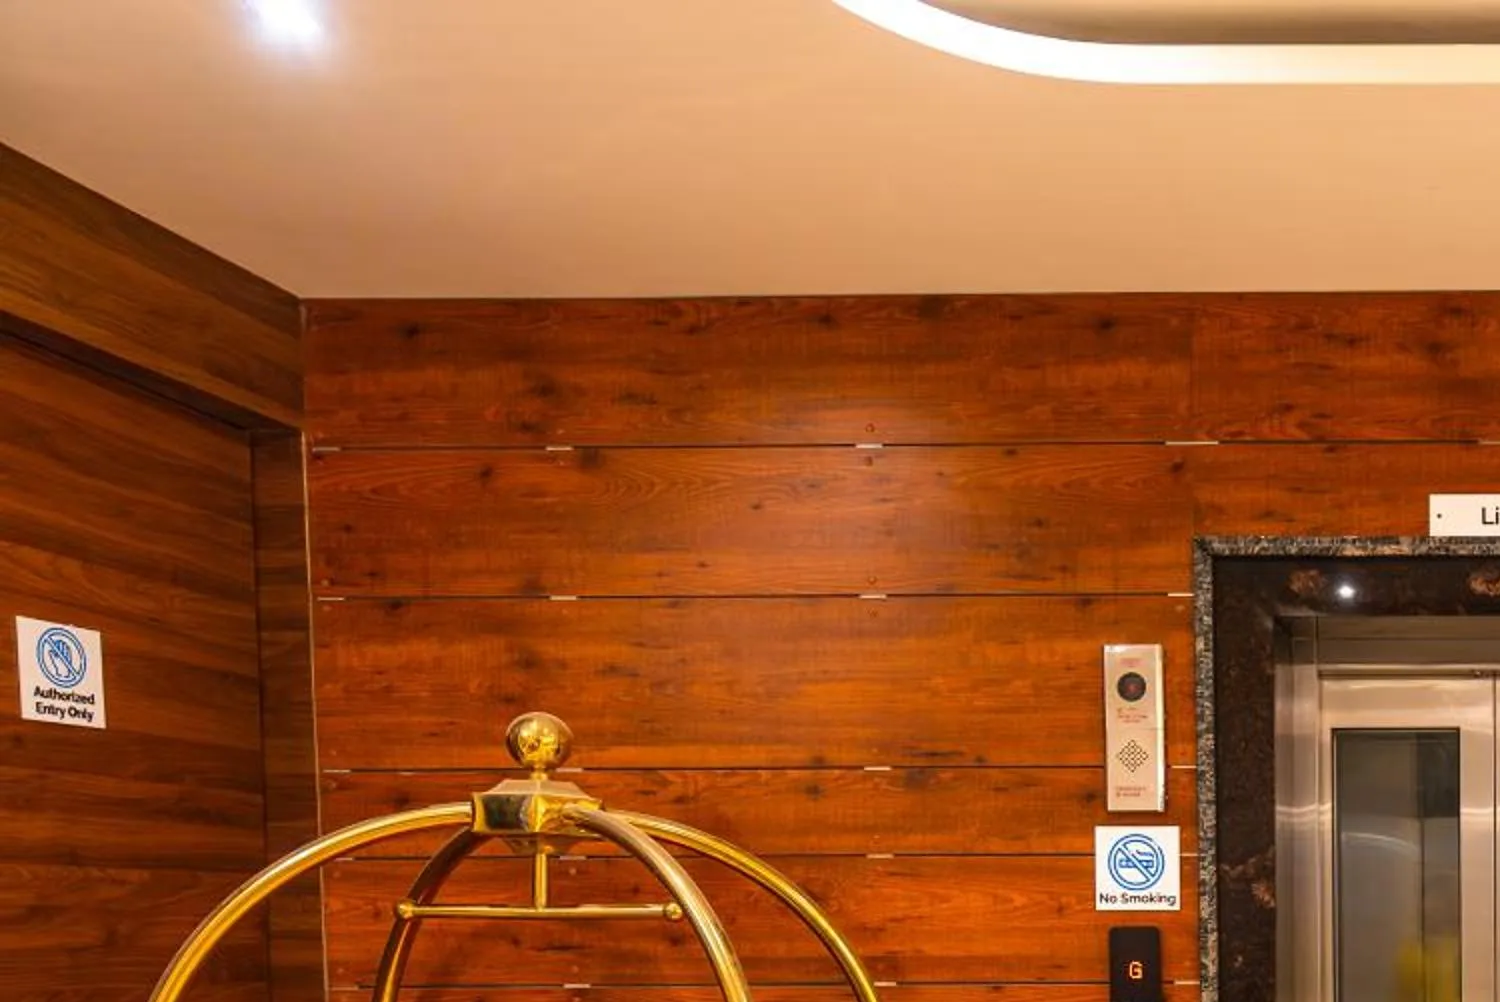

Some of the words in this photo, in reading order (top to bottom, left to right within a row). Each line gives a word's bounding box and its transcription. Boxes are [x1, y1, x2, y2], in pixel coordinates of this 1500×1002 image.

[34, 686, 95, 705] Authorized
[36, 701, 66, 719] Entry
[68, 706, 94, 722] Only
[1100, 892, 1117, 905] No
[1120, 892, 1177, 906] Smoking
[1128, 961, 1143, 979] G
